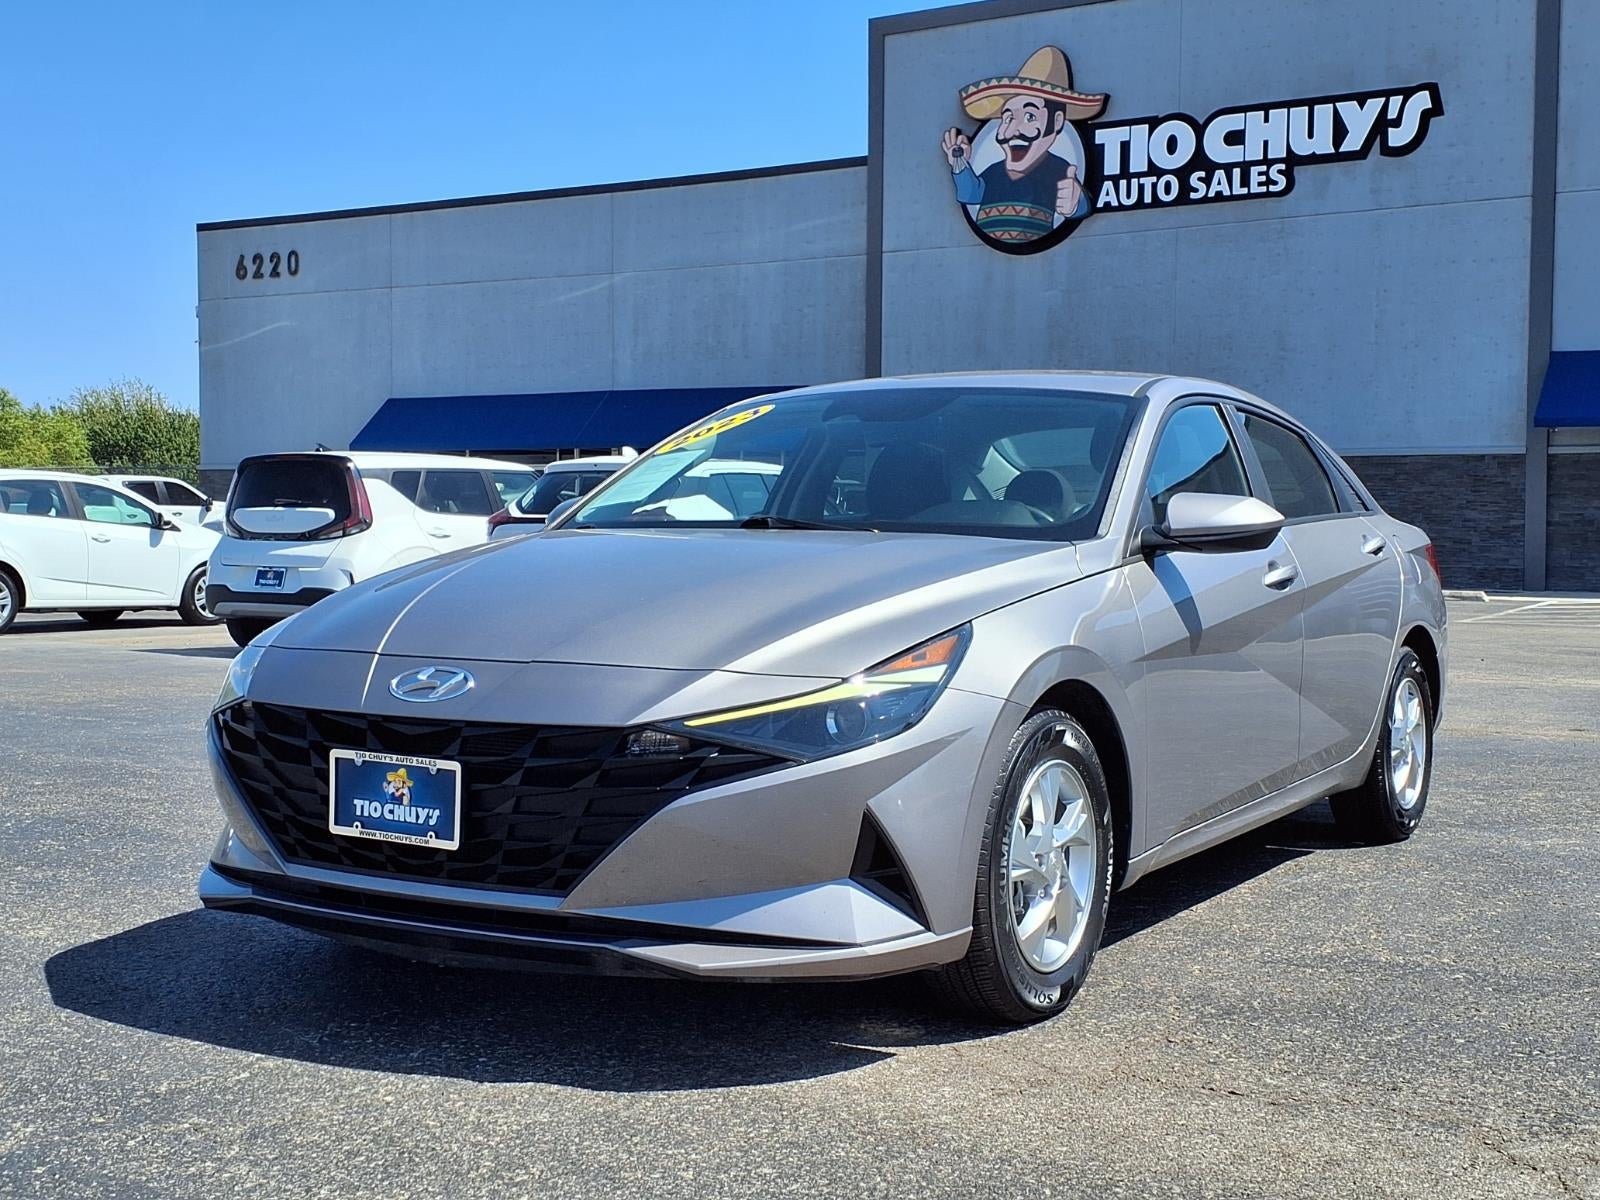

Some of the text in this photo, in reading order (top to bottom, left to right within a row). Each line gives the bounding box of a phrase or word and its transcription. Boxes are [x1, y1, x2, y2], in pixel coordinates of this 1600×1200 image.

[1095, 90, 1432, 176] TIO CHUY'S
[1096, 163, 1287, 208] AUTO SALES
[235, 249, 299, 280] 6220
[354, 751, 438, 768] TIO CHUY'S AUTO SALES
[353, 799, 440, 826] TIO CHUY'S
[358, 829, 430, 845] WWW.TIOCHUYS.COM
